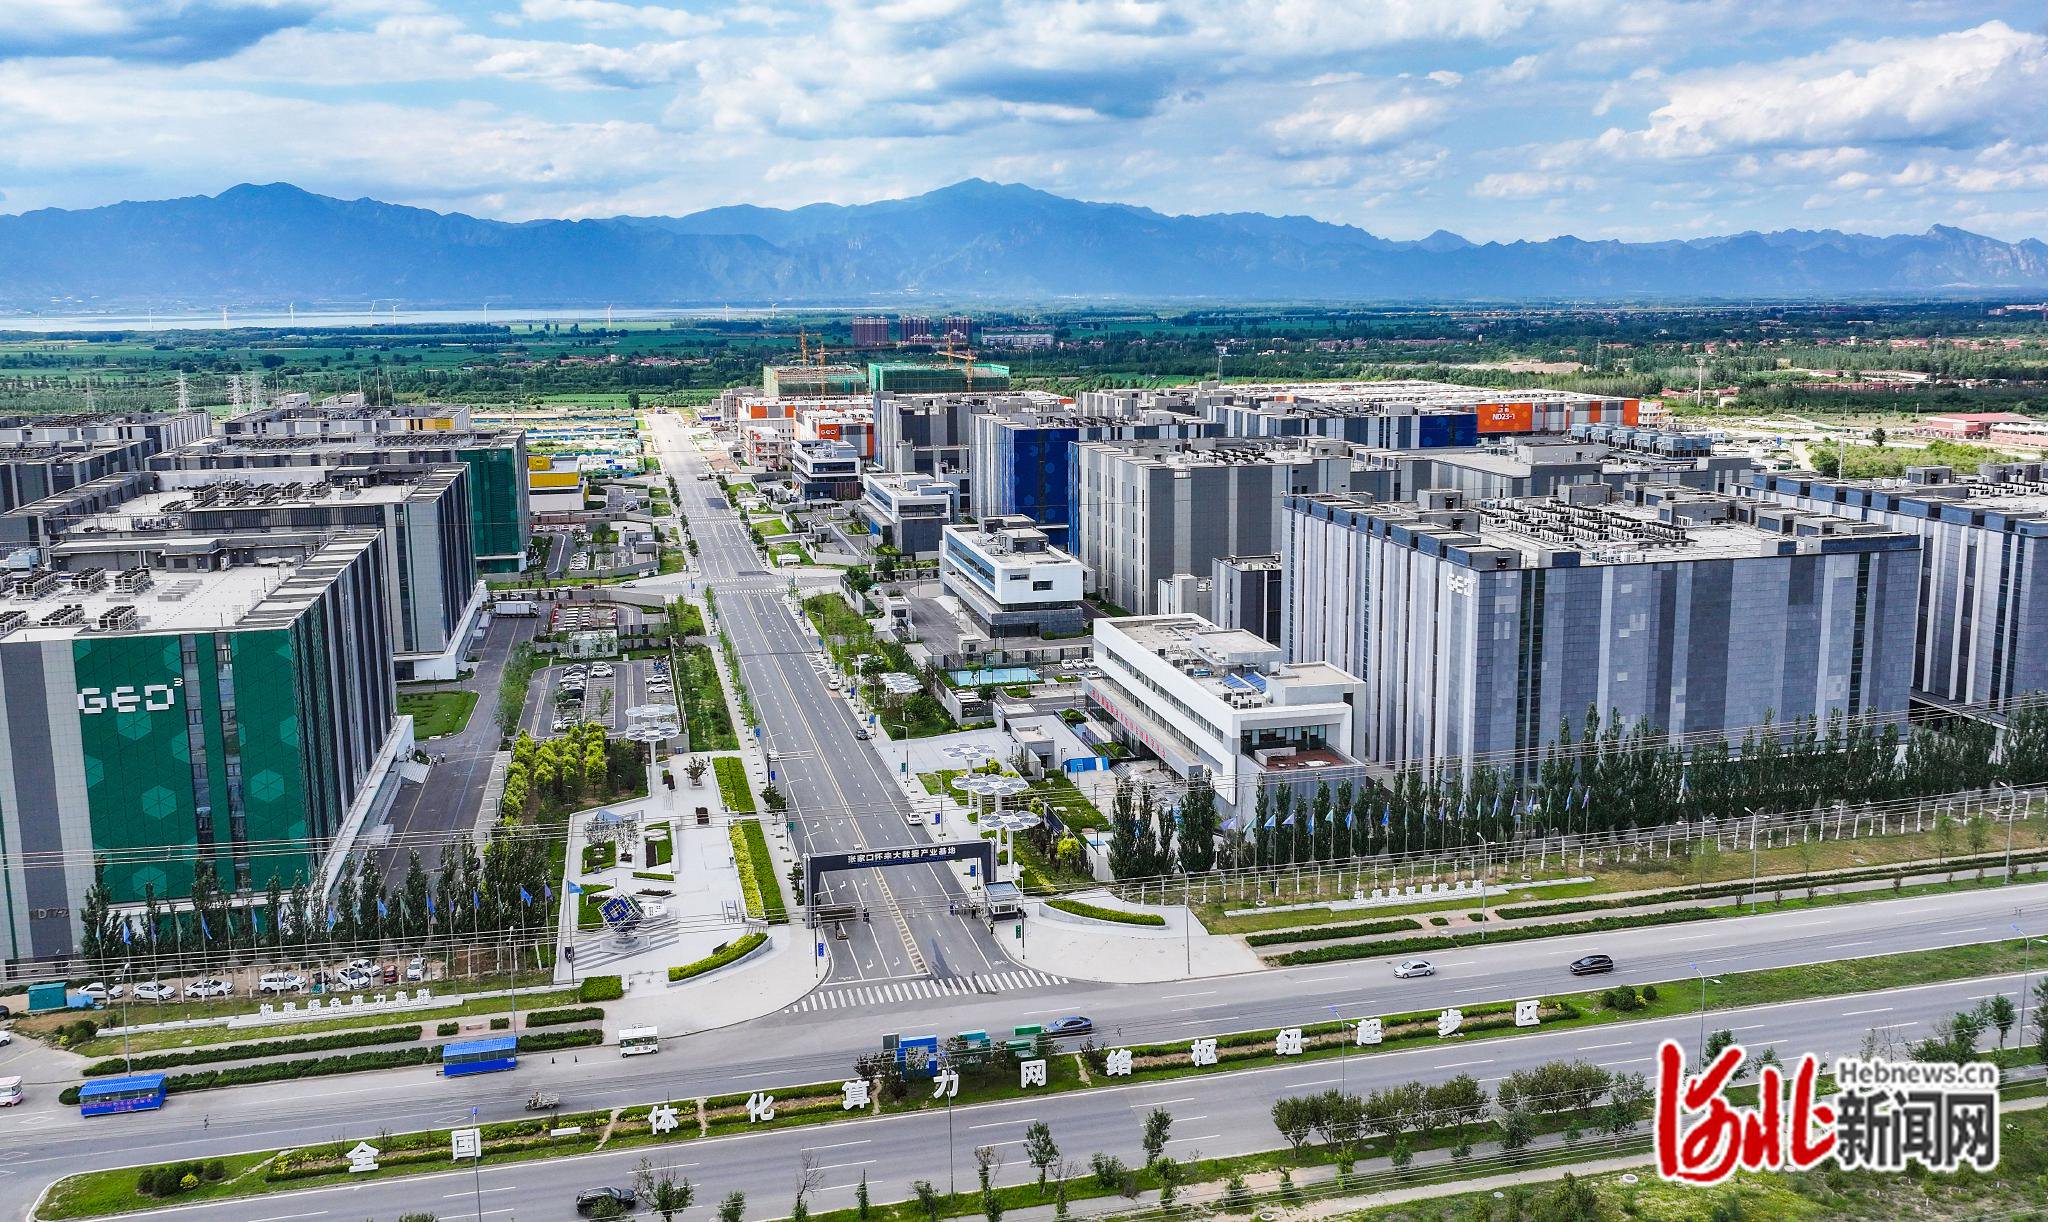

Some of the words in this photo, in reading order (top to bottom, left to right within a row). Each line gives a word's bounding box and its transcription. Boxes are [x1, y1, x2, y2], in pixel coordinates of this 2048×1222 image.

[1492, 413, 1516, 421] ND23-1
[847, 846, 957, 864] 张家口怀来大数据产业基地
